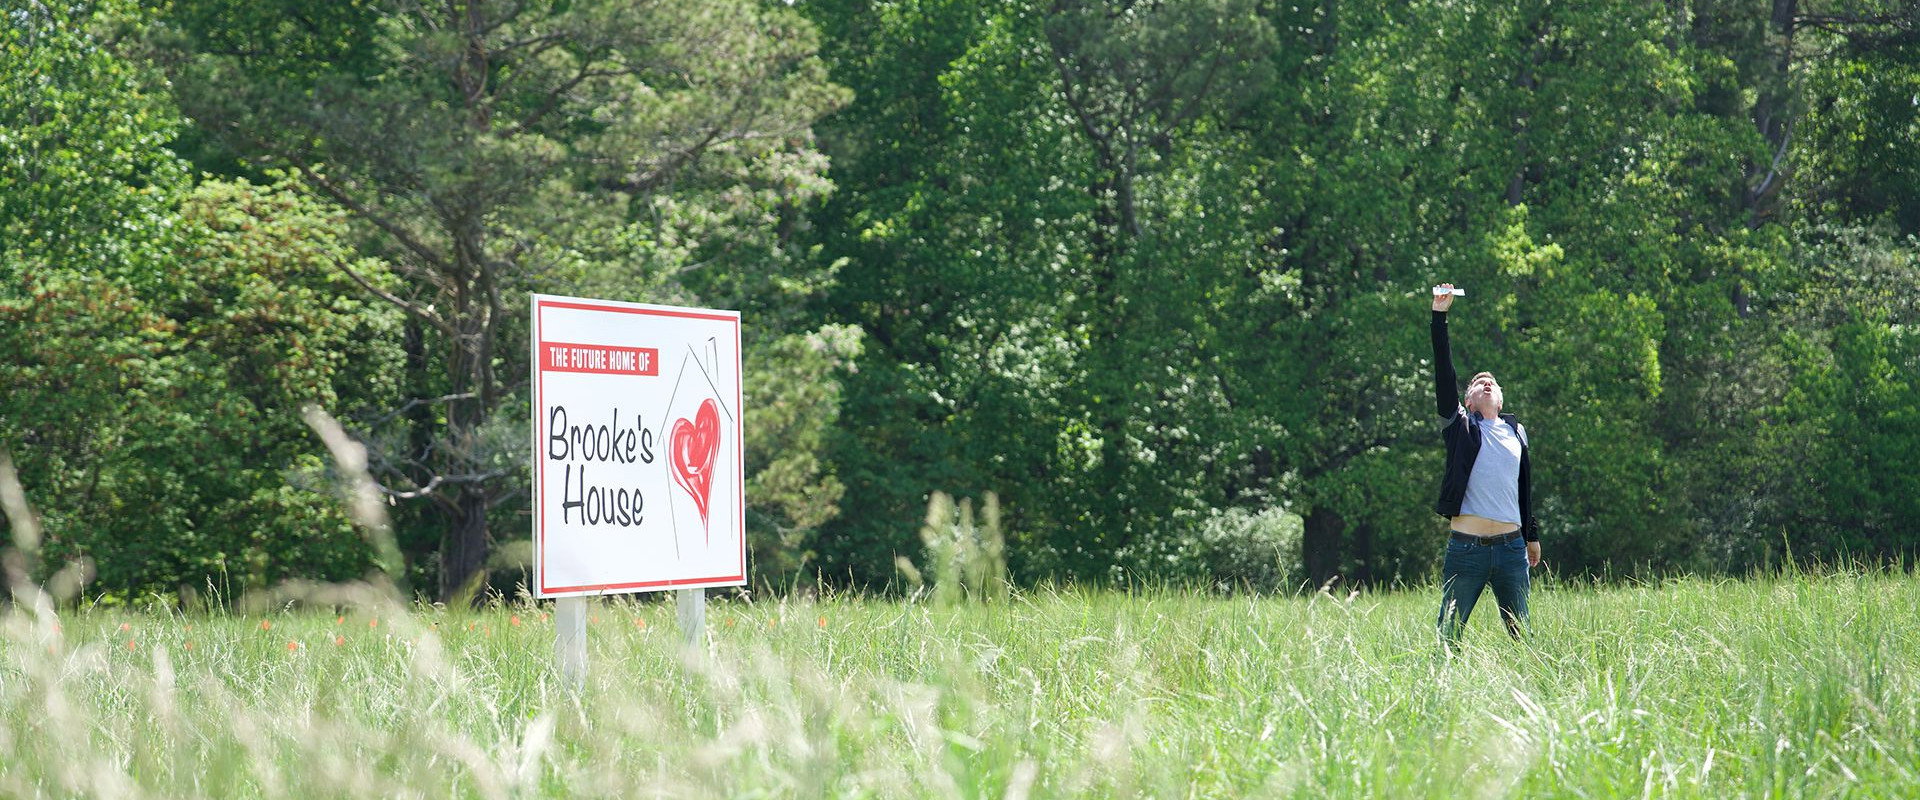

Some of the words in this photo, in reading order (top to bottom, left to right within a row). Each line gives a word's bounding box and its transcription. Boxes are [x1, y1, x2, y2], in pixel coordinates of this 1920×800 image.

[549, 346, 568, 367] THE
[571, 348, 607, 369] FUTURE
[609, 350, 636, 371] HOME
[639, 352, 650, 372] OF
[549, 405, 654, 464] Brooke's
[562, 464, 643, 527] House
